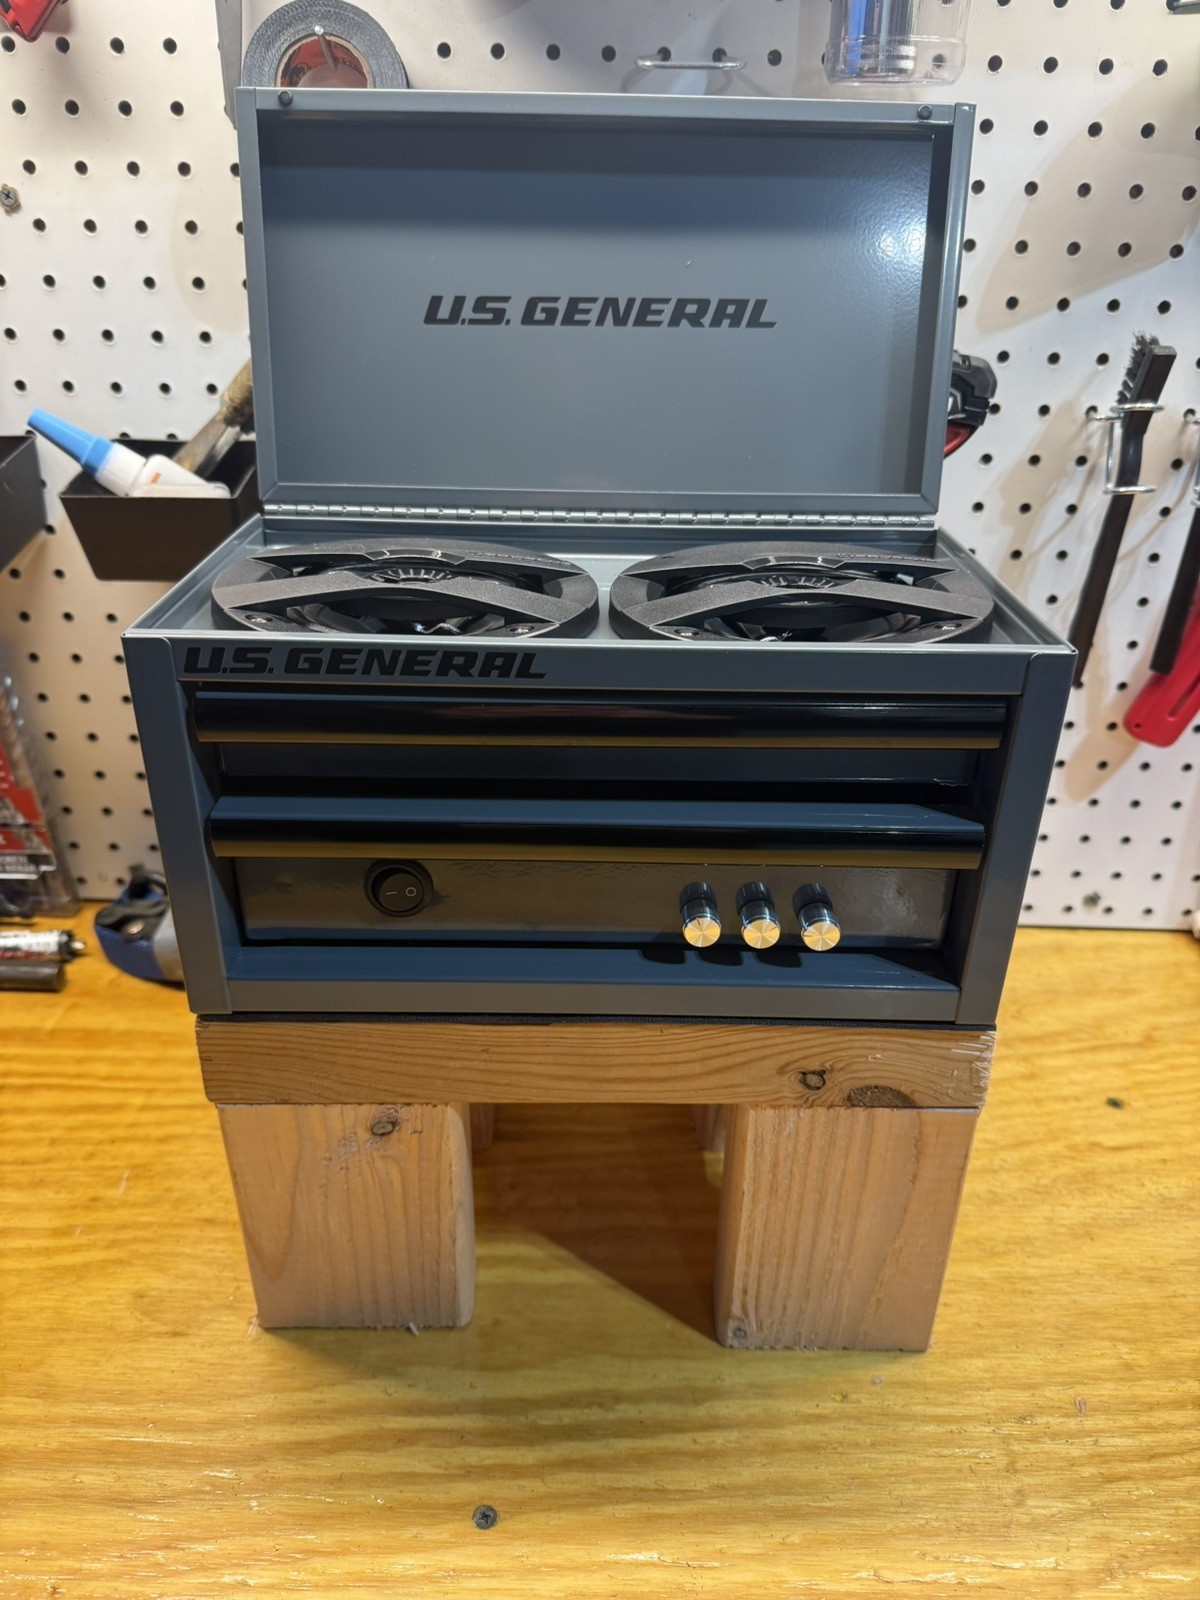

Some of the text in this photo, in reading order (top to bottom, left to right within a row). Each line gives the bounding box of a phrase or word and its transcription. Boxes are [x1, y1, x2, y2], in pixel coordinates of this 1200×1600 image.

[423, 295, 777, 328] U.S. GENERAL
[183, 647, 547, 679] U.S. GENERAL
